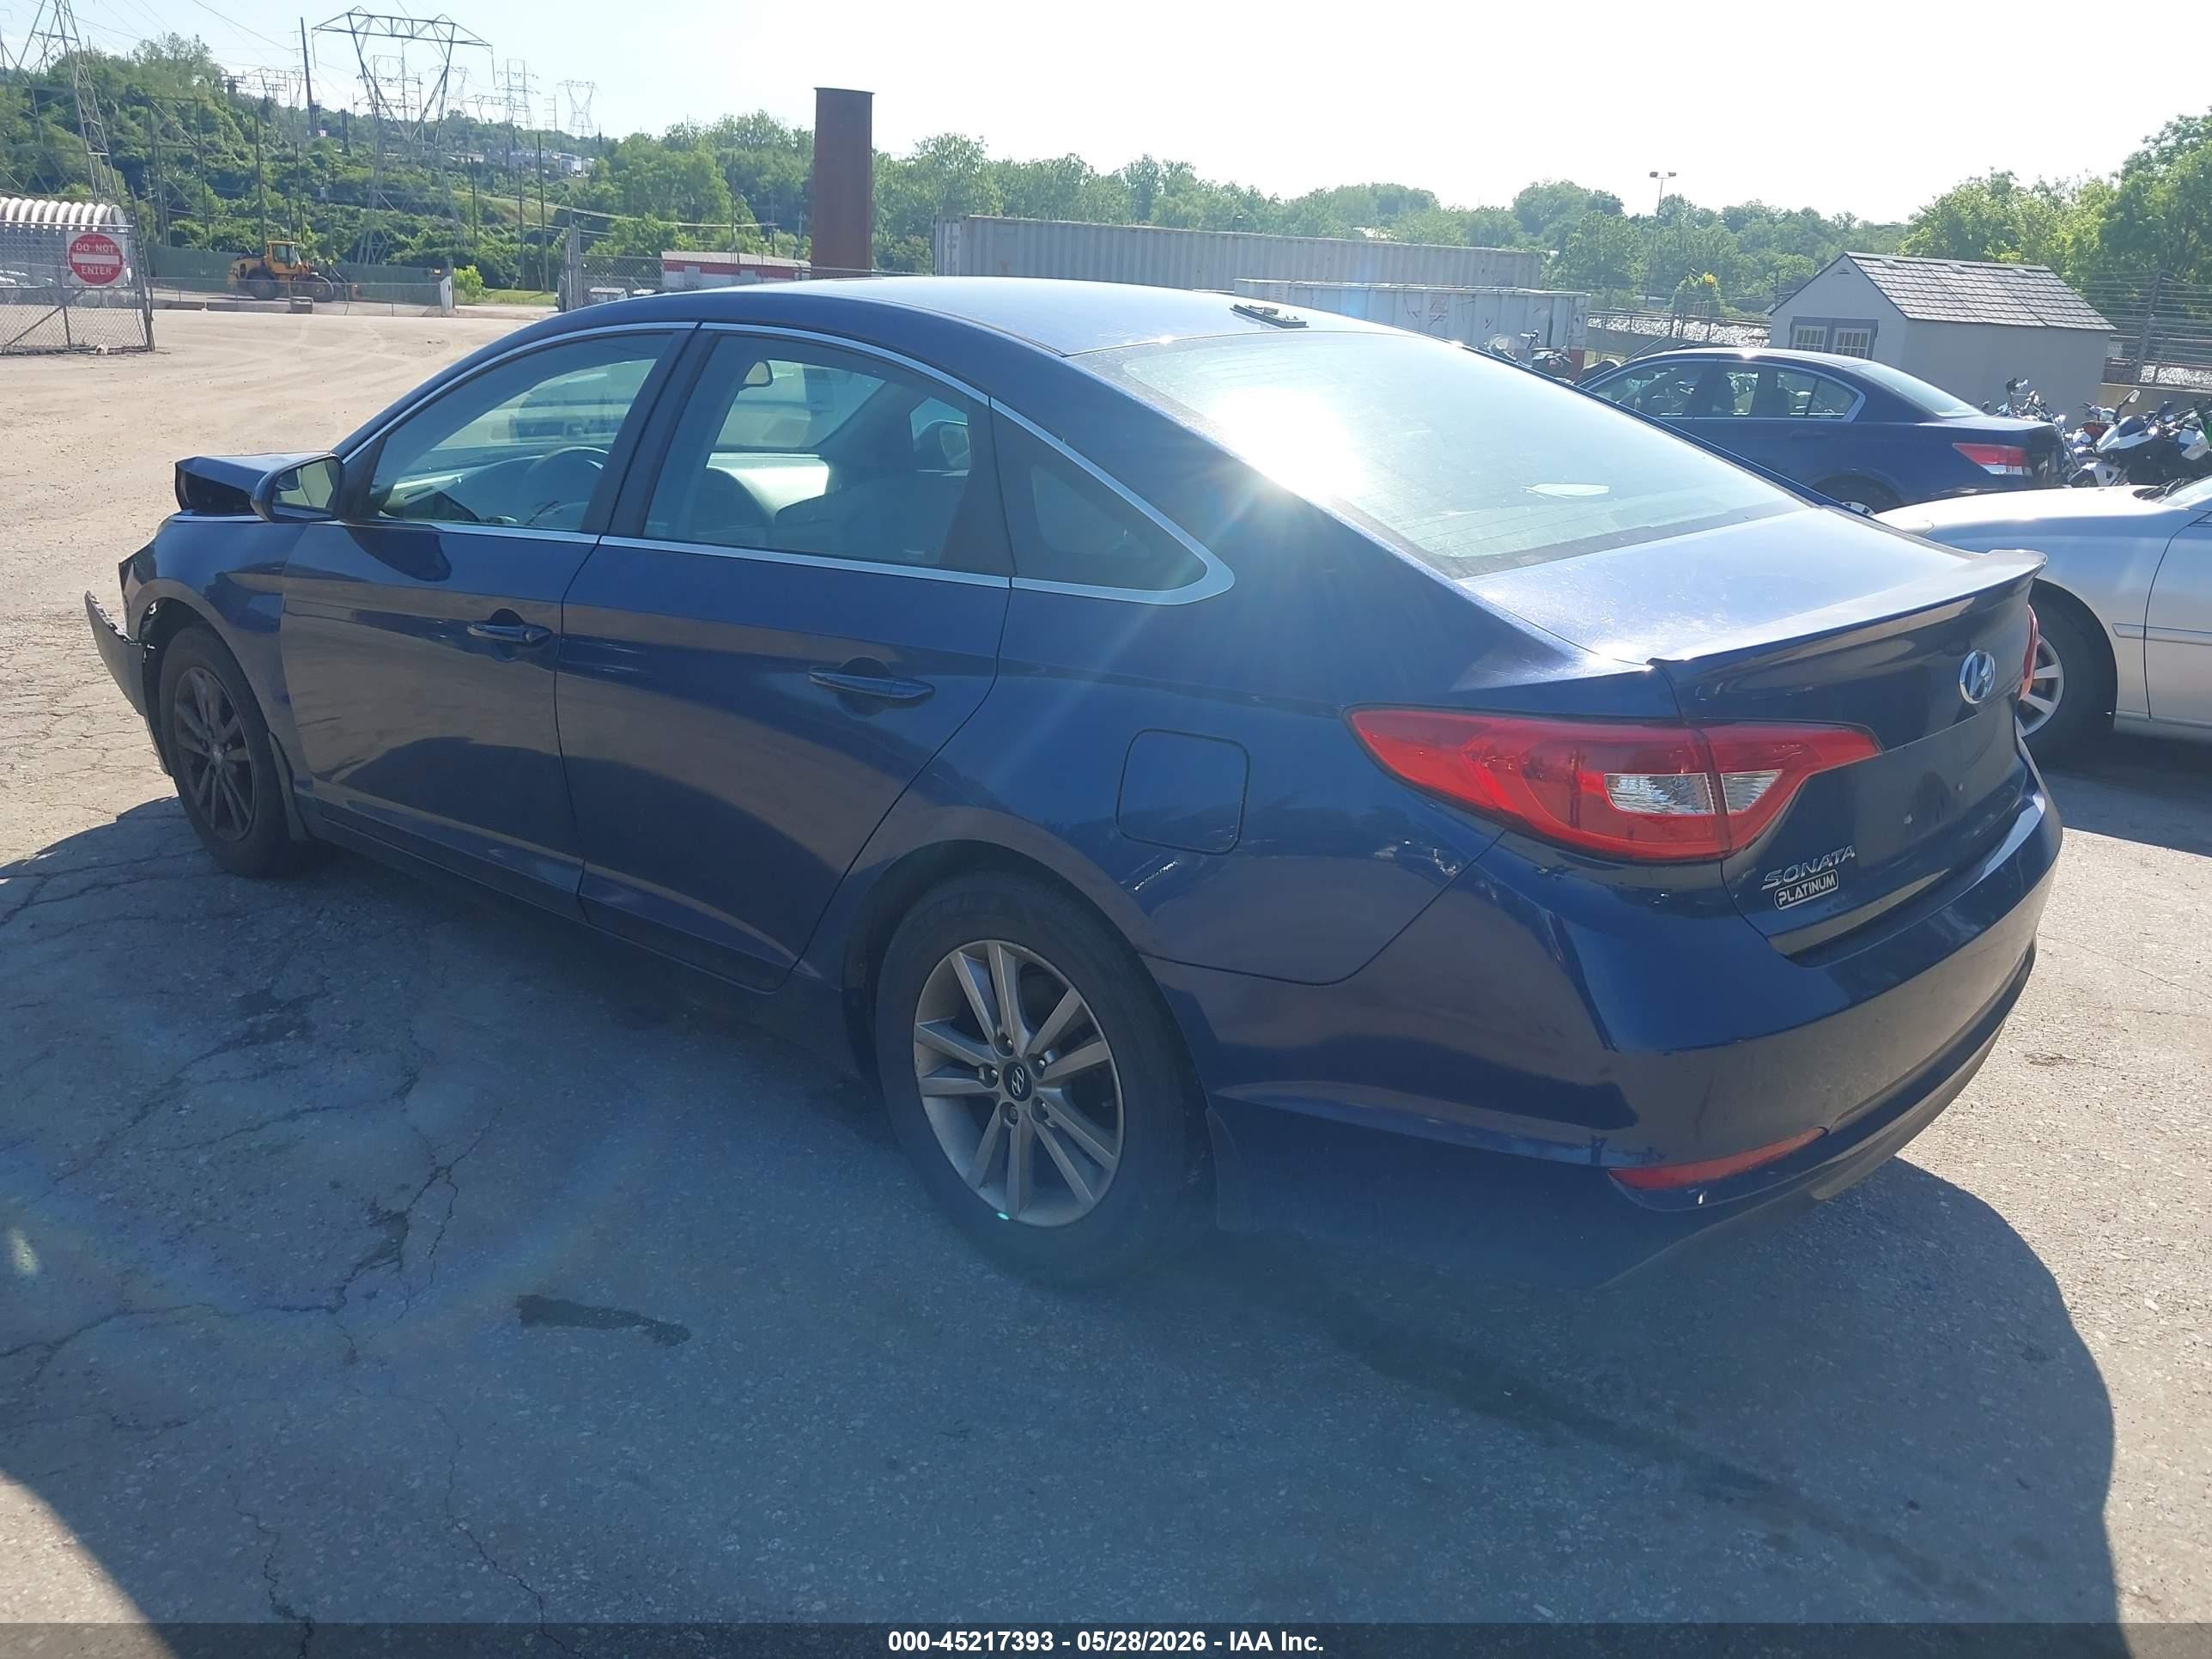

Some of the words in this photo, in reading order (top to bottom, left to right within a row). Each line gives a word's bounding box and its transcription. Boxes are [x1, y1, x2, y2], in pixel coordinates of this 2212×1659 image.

[76, 242, 89, 252] DO
[95, 243, 114, 254] NOT
[81, 265, 112, 276] ENTER
[1761, 845, 1856, 890] SONATA
[1778, 873, 1836, 906] PLATINUM
